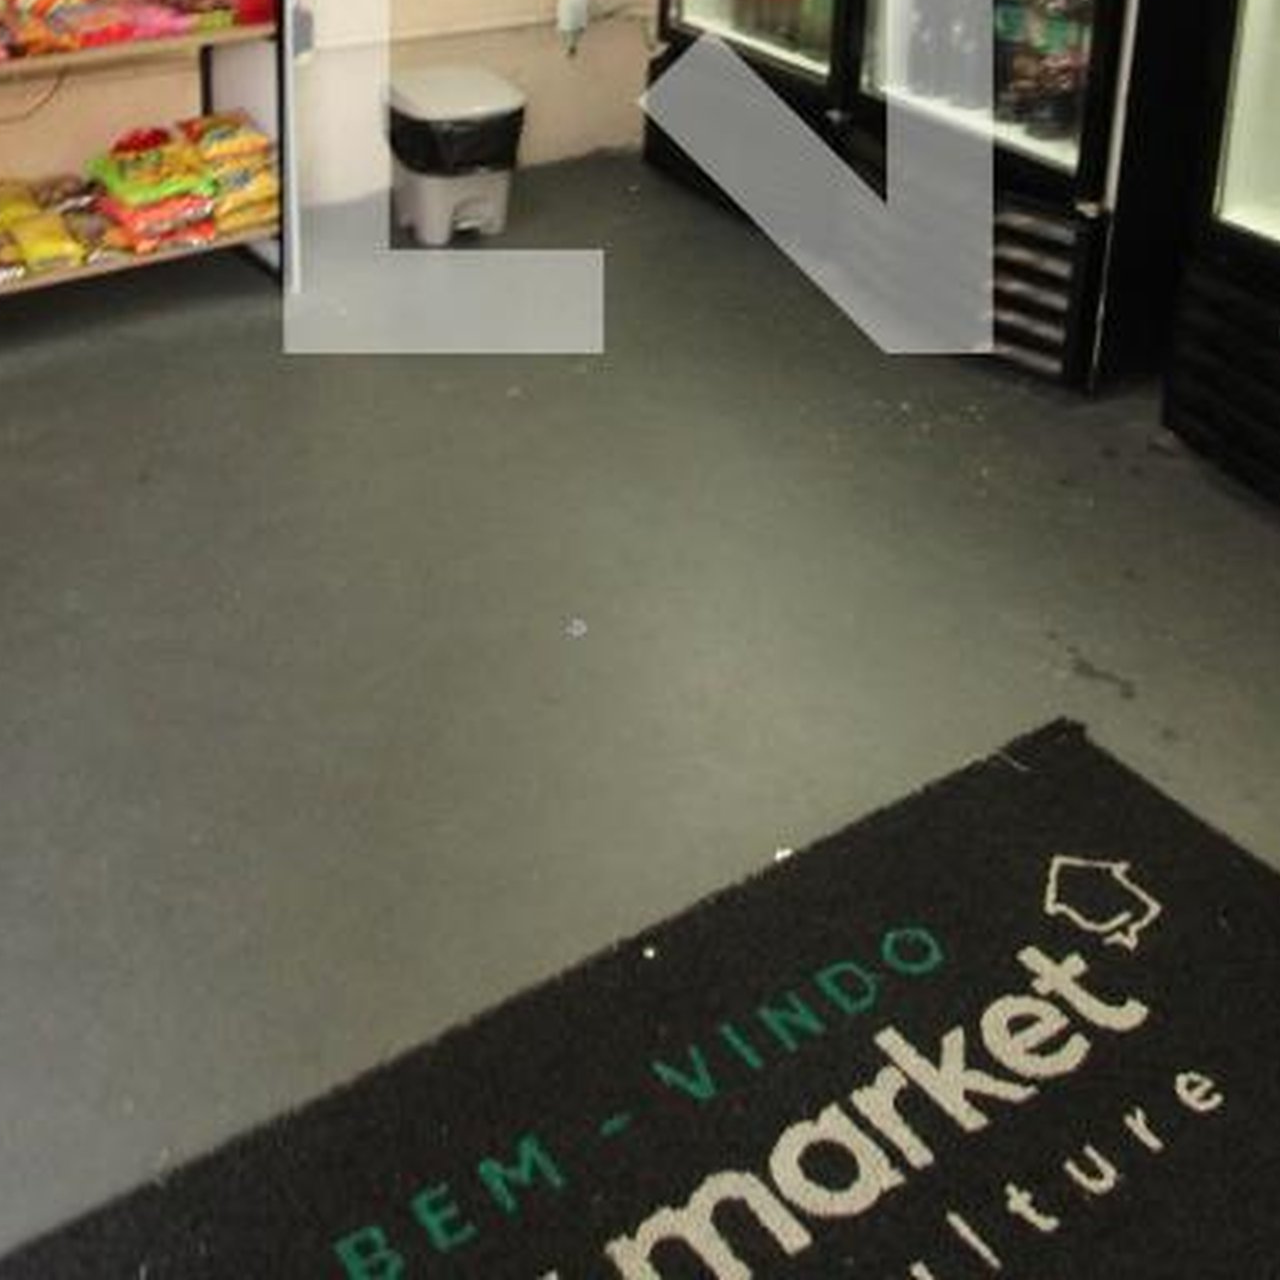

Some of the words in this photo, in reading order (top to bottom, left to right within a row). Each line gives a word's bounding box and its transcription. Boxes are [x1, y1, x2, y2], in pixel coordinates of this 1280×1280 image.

[333, 1132, 568, 1280] BEM
[649, 926, 946, 1101] VINDO
[604, 945, 1150, 1280] market
